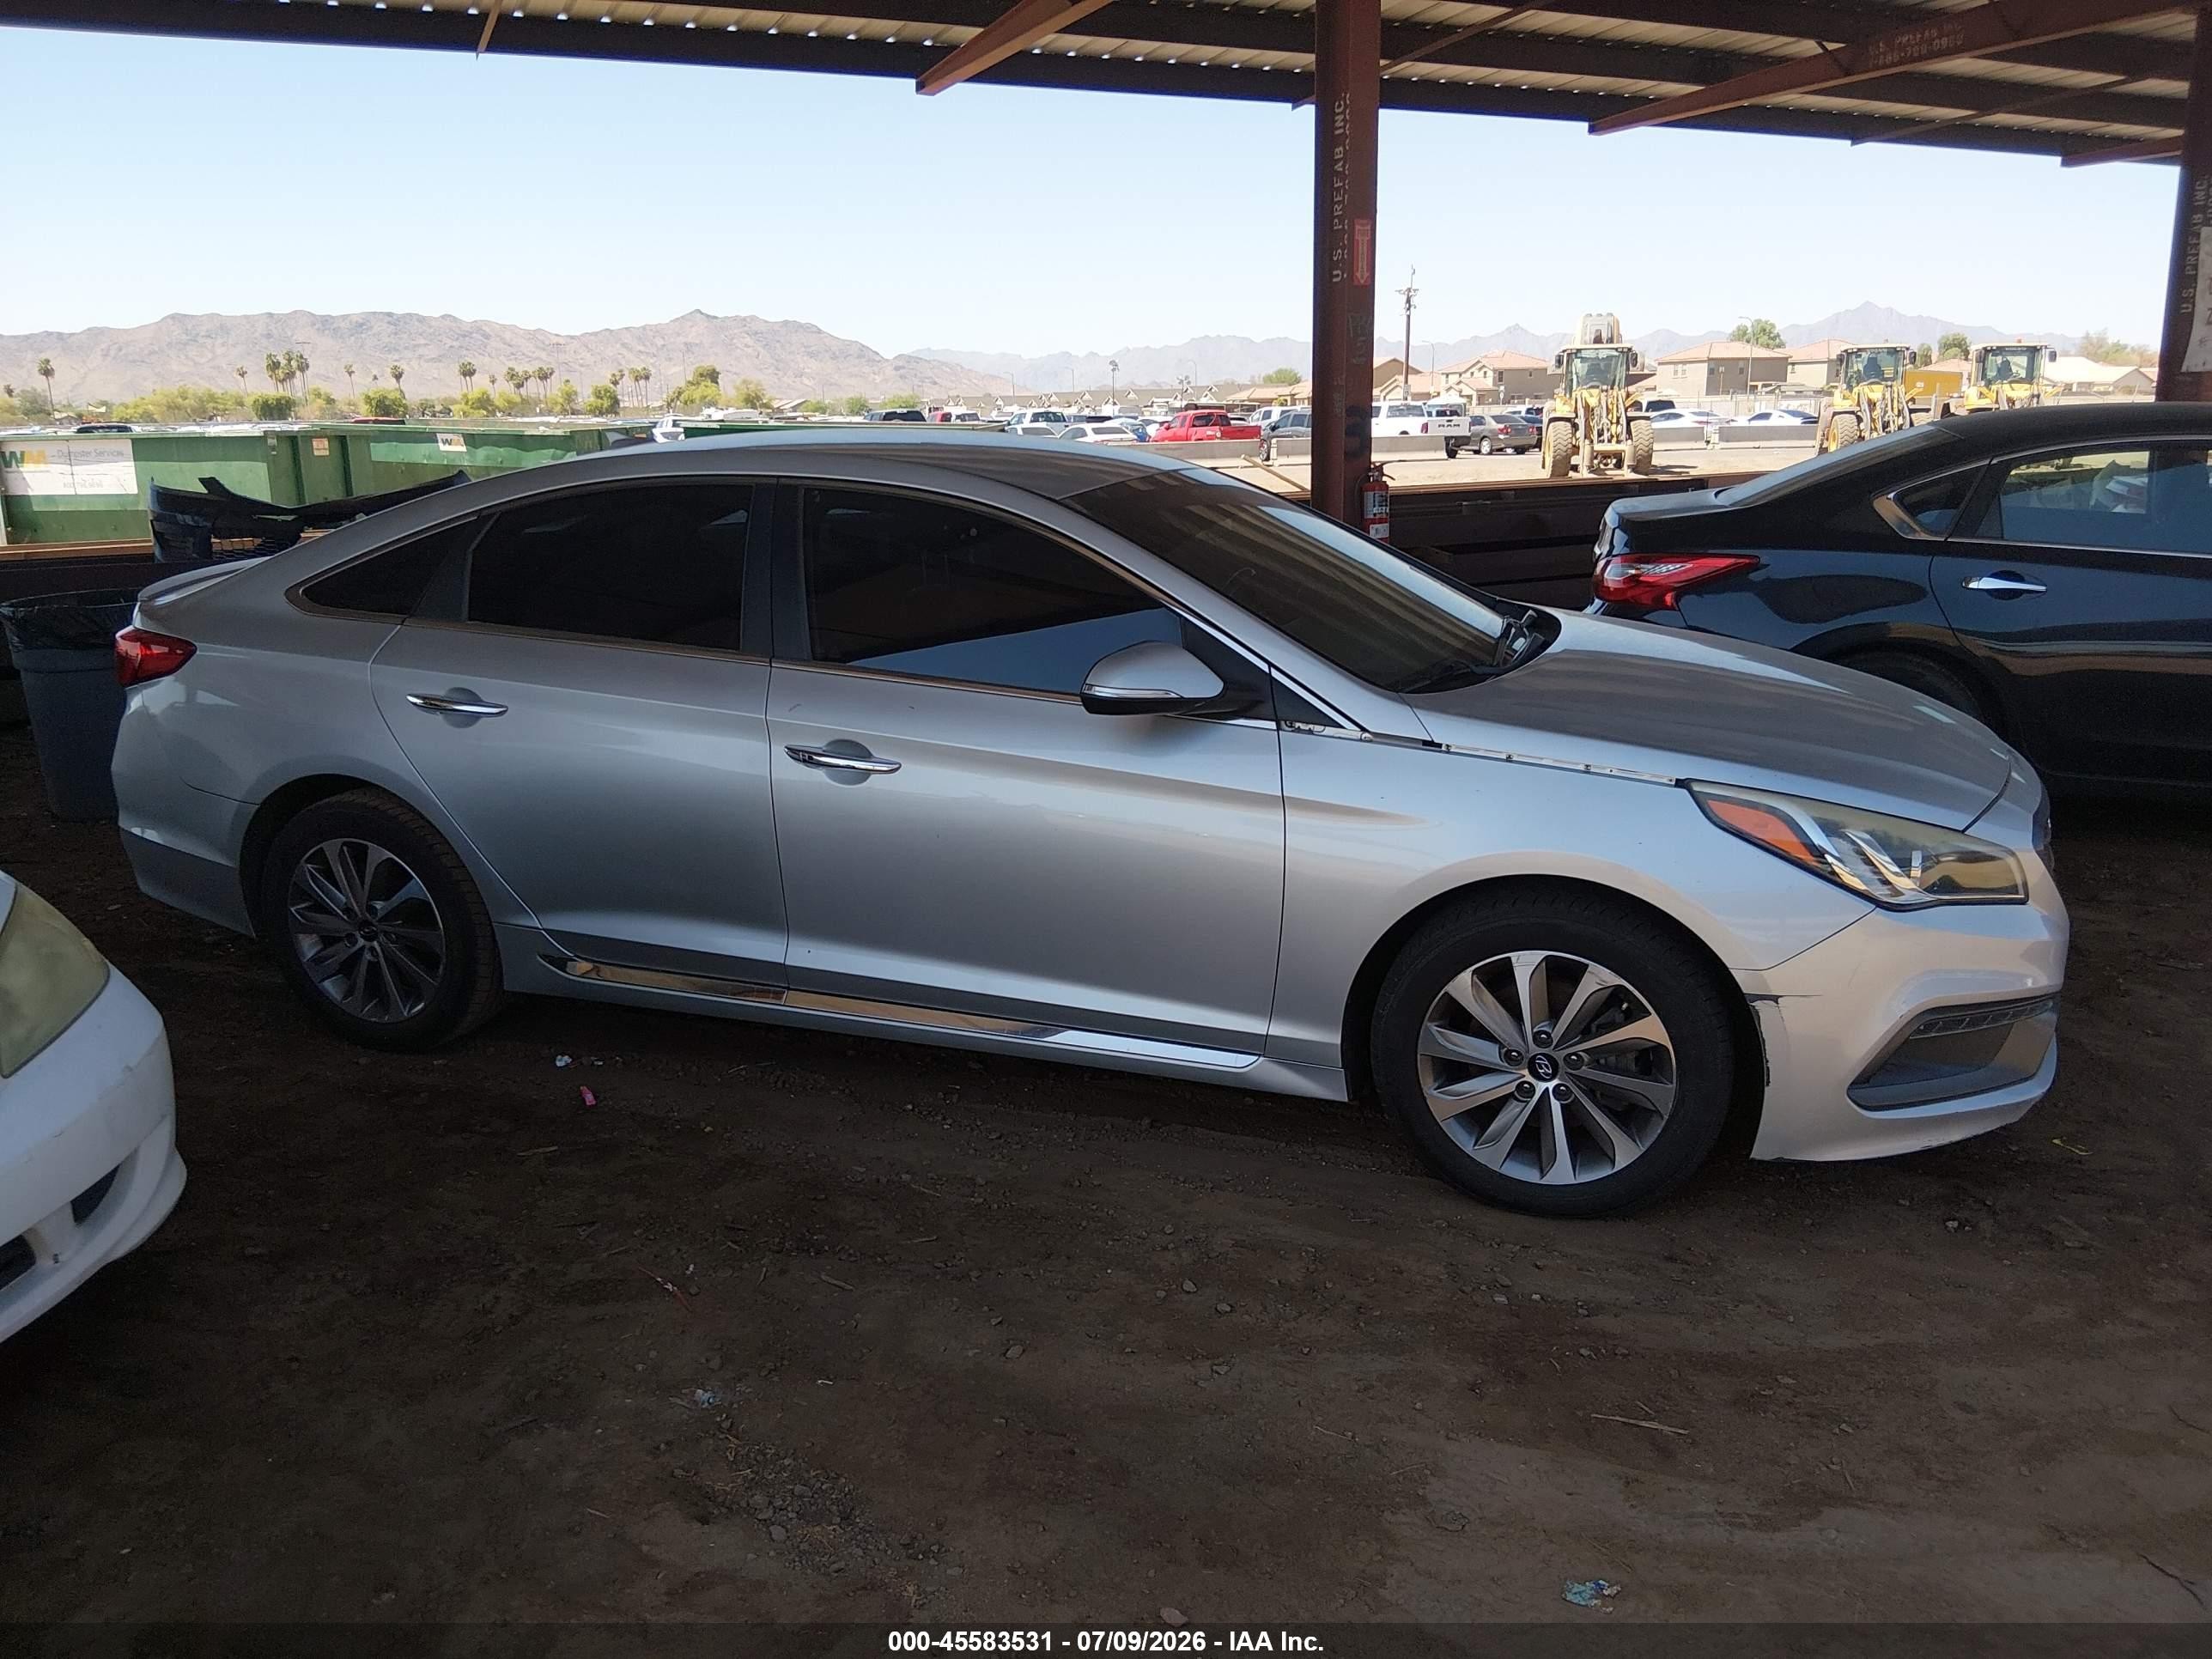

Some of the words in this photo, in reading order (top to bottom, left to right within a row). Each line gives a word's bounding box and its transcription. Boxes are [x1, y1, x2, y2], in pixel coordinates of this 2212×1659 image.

[1333, 91, 1346, 136] INC.
[1332, 145, 1345, 229] PREFAB
[1332, 241, 1343, 283] U.S.
